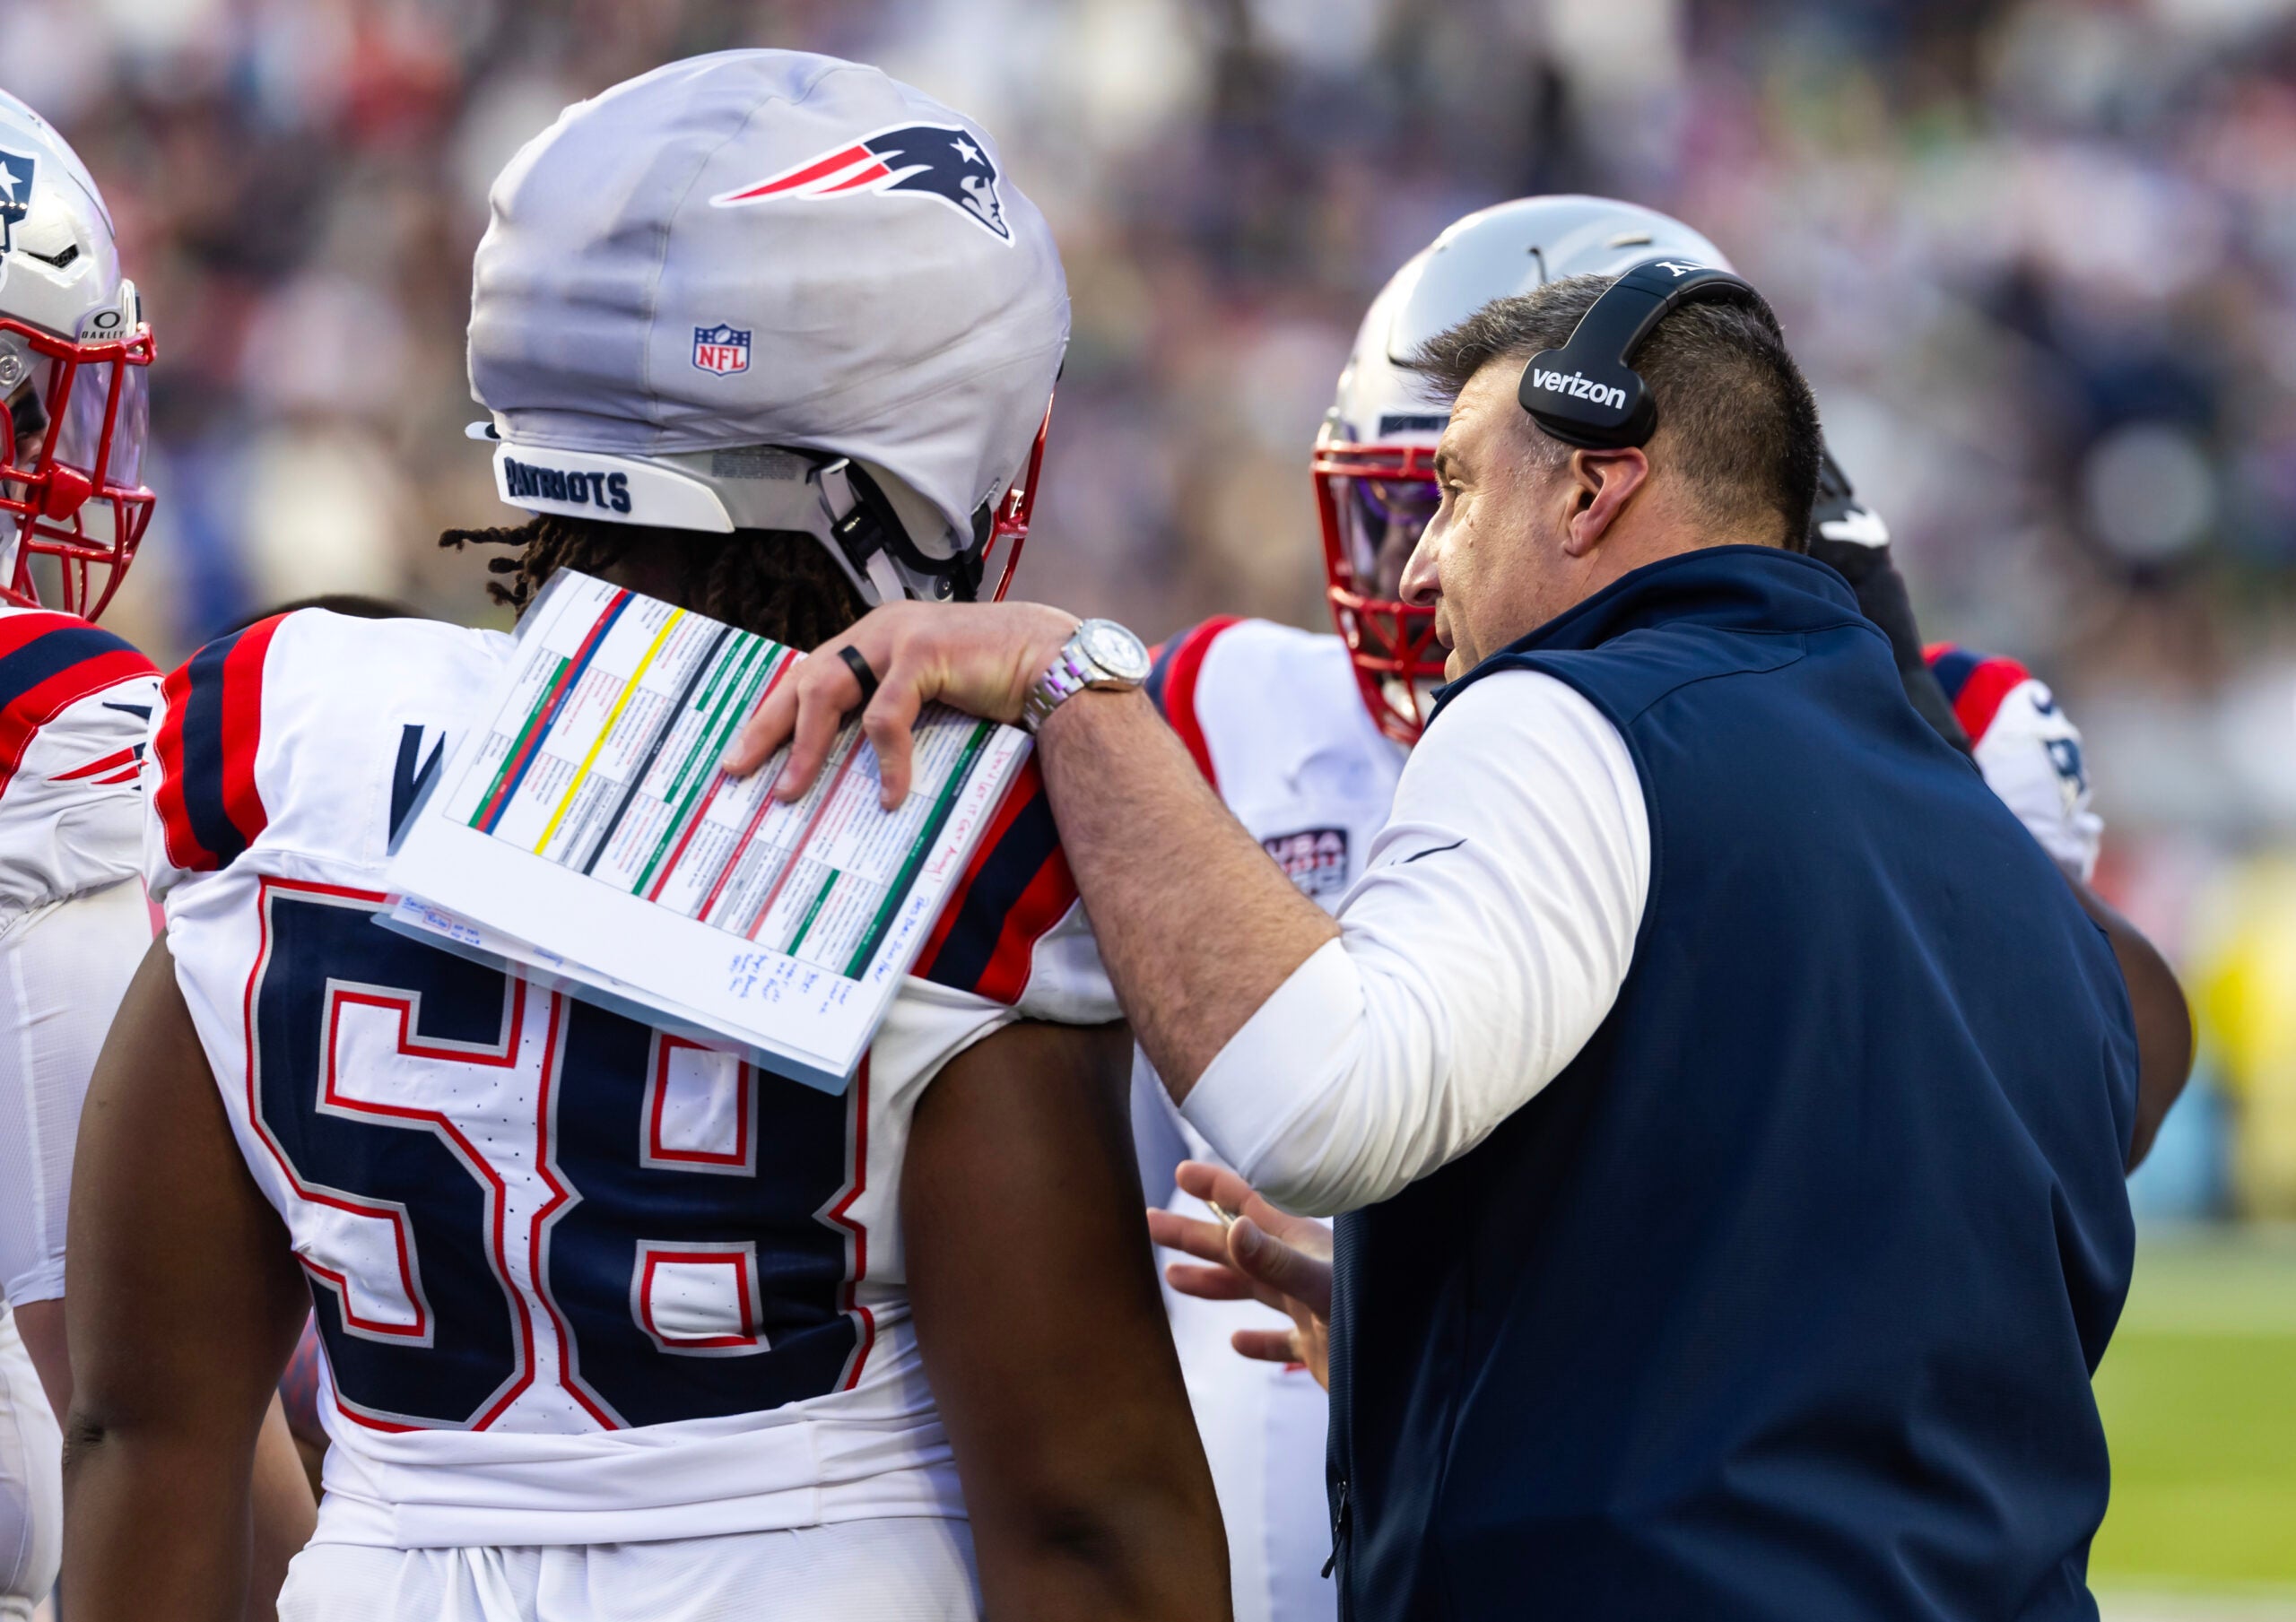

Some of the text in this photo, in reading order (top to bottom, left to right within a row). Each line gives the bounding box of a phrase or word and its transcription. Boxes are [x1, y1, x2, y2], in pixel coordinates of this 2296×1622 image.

[82, 331, 124, 339] OAKLEY
[697, 346, 745, 370] NFL
[1533, 369, 1626, 409] verizon
[504, 456, 631, 514] PATRIOTS
[244, 874, 874, 1434] 58
